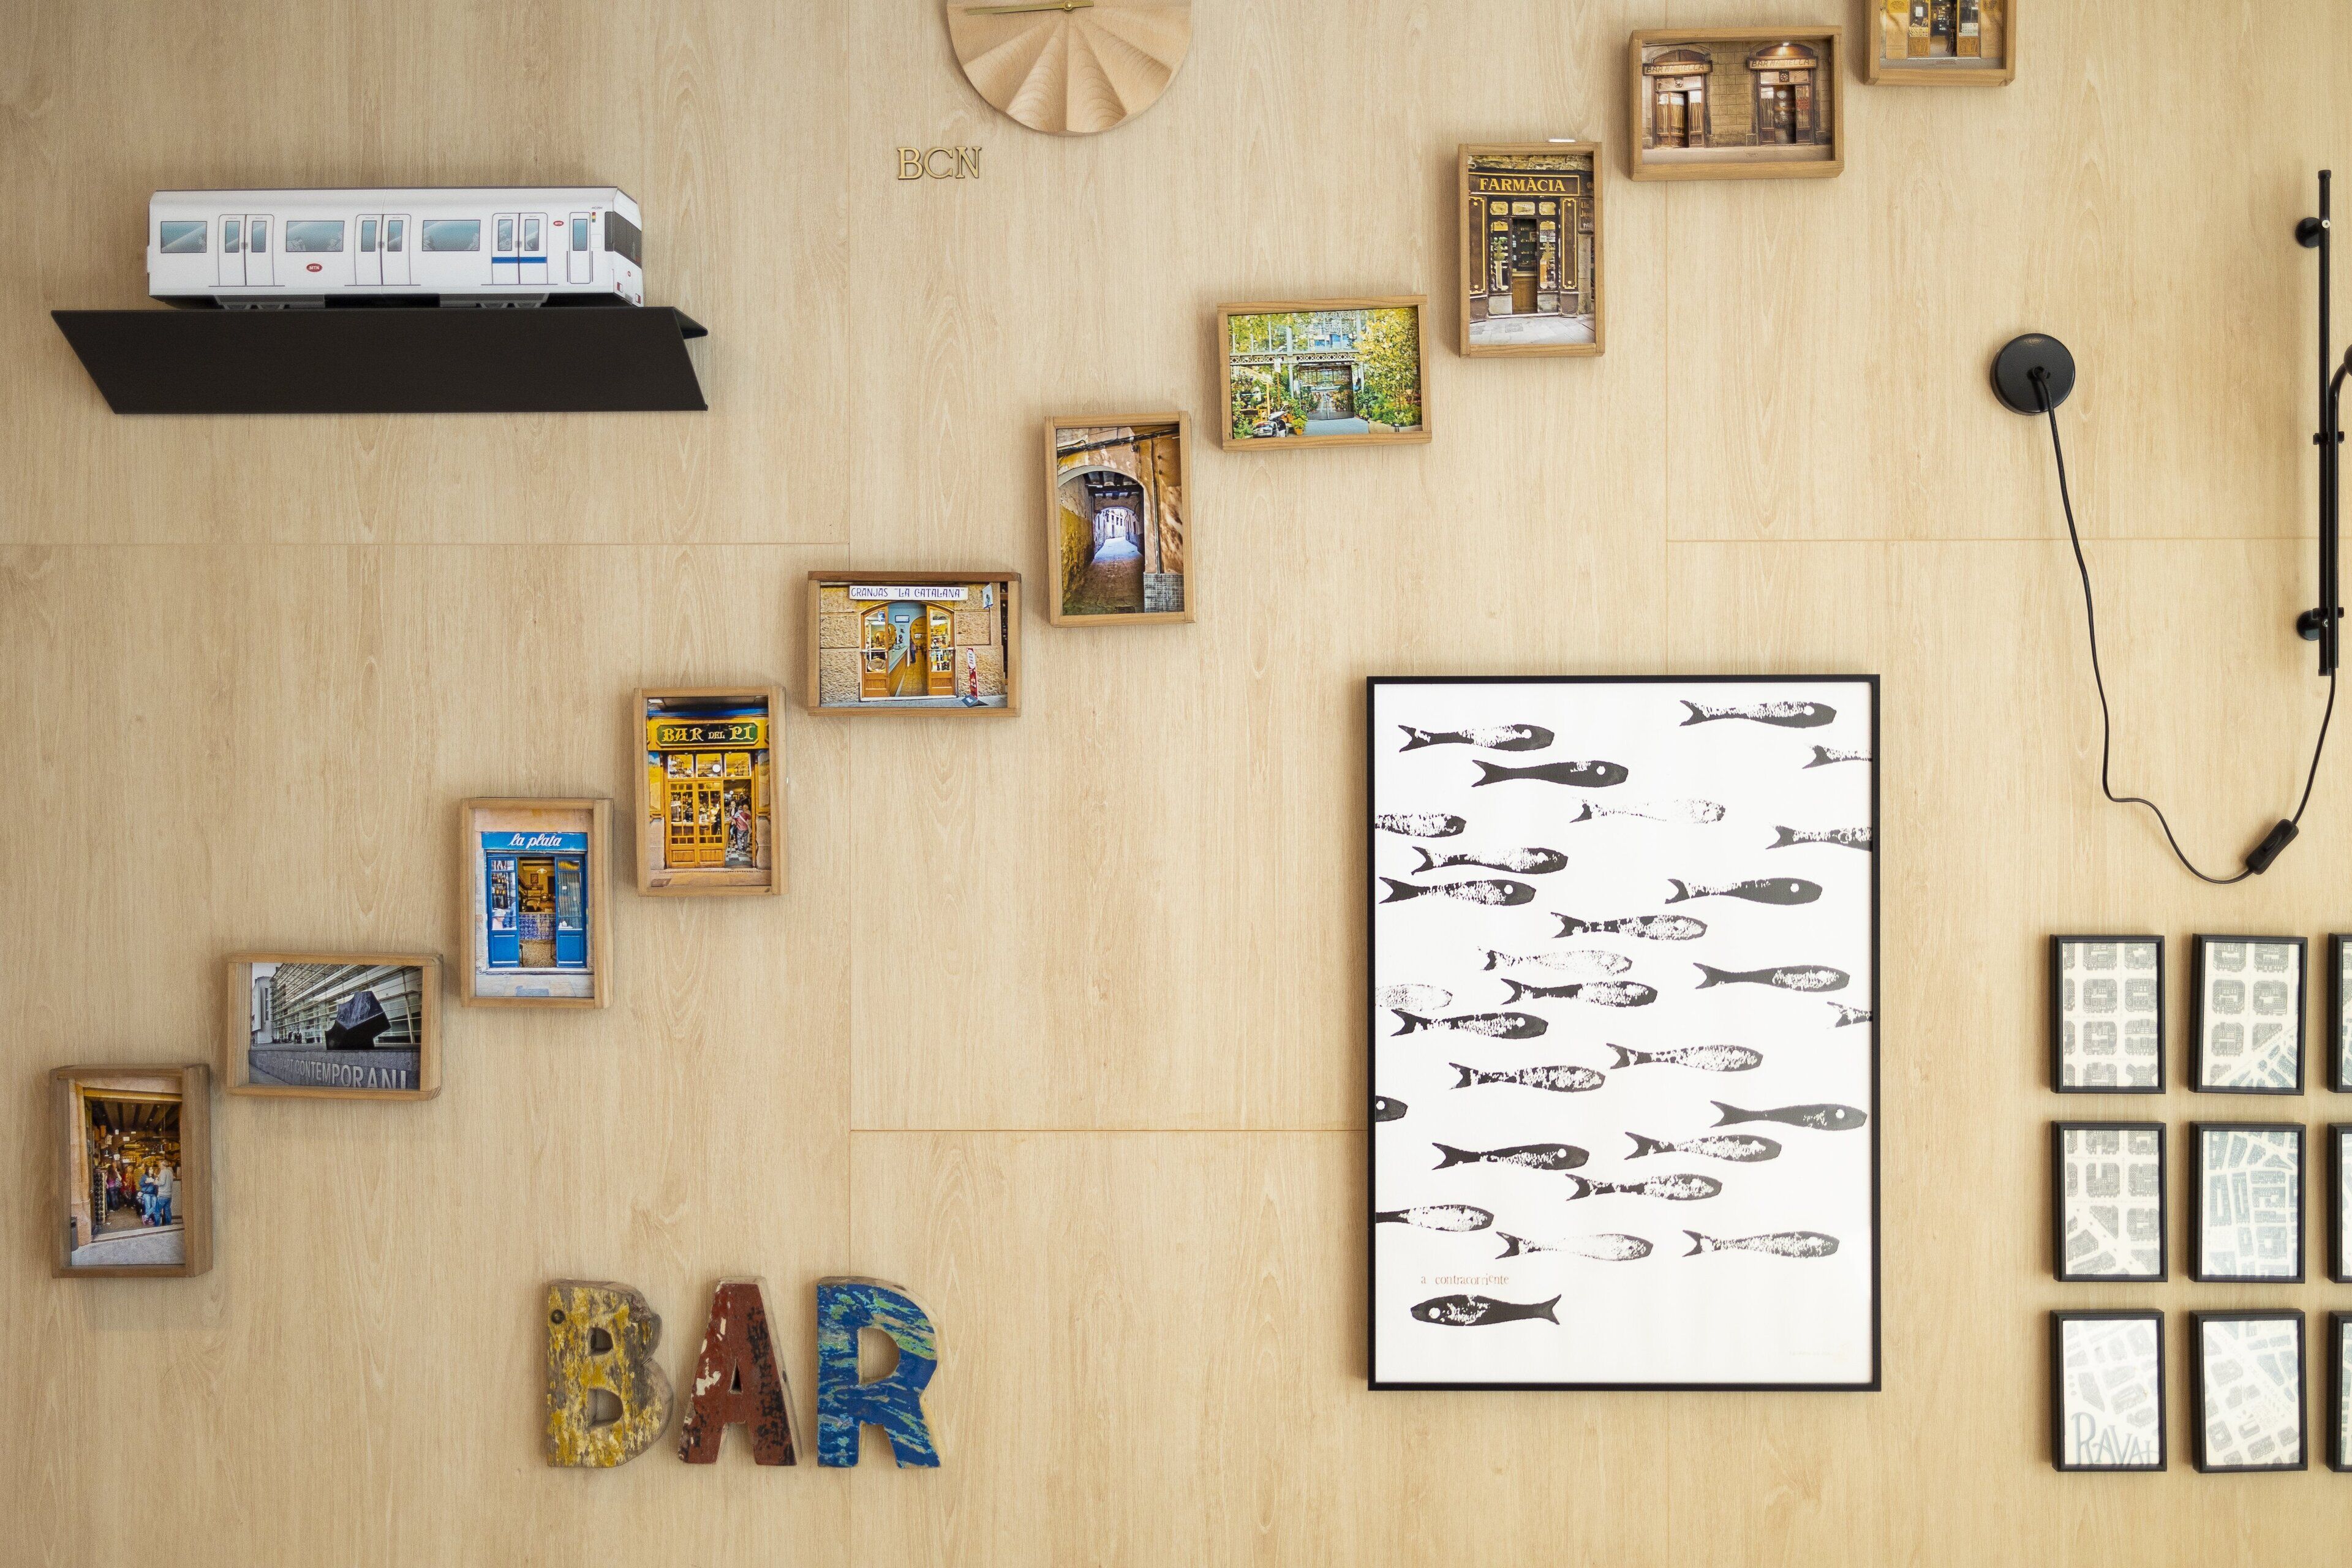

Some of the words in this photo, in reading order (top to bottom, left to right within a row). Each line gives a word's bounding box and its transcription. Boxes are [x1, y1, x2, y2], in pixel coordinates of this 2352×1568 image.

[897, 146, 982, 180] BCN
[1479, 178, 1566, 192] FARMÀCIA
[662, 727, 704, 742] BAR
[708, 731, 726, 740] DEL
[729, 725, 753, 740] PI
[507, 833, 526, 846] la
[526, 833, 562, 850] plata
[295, 1060, 406, 1089] CONTEMPORANI
[1420, 1275, 1427, 1284] a
[1434, 1273, 1510, 1286] contracorriente
[547, 1276, 943, 1469] BAR
